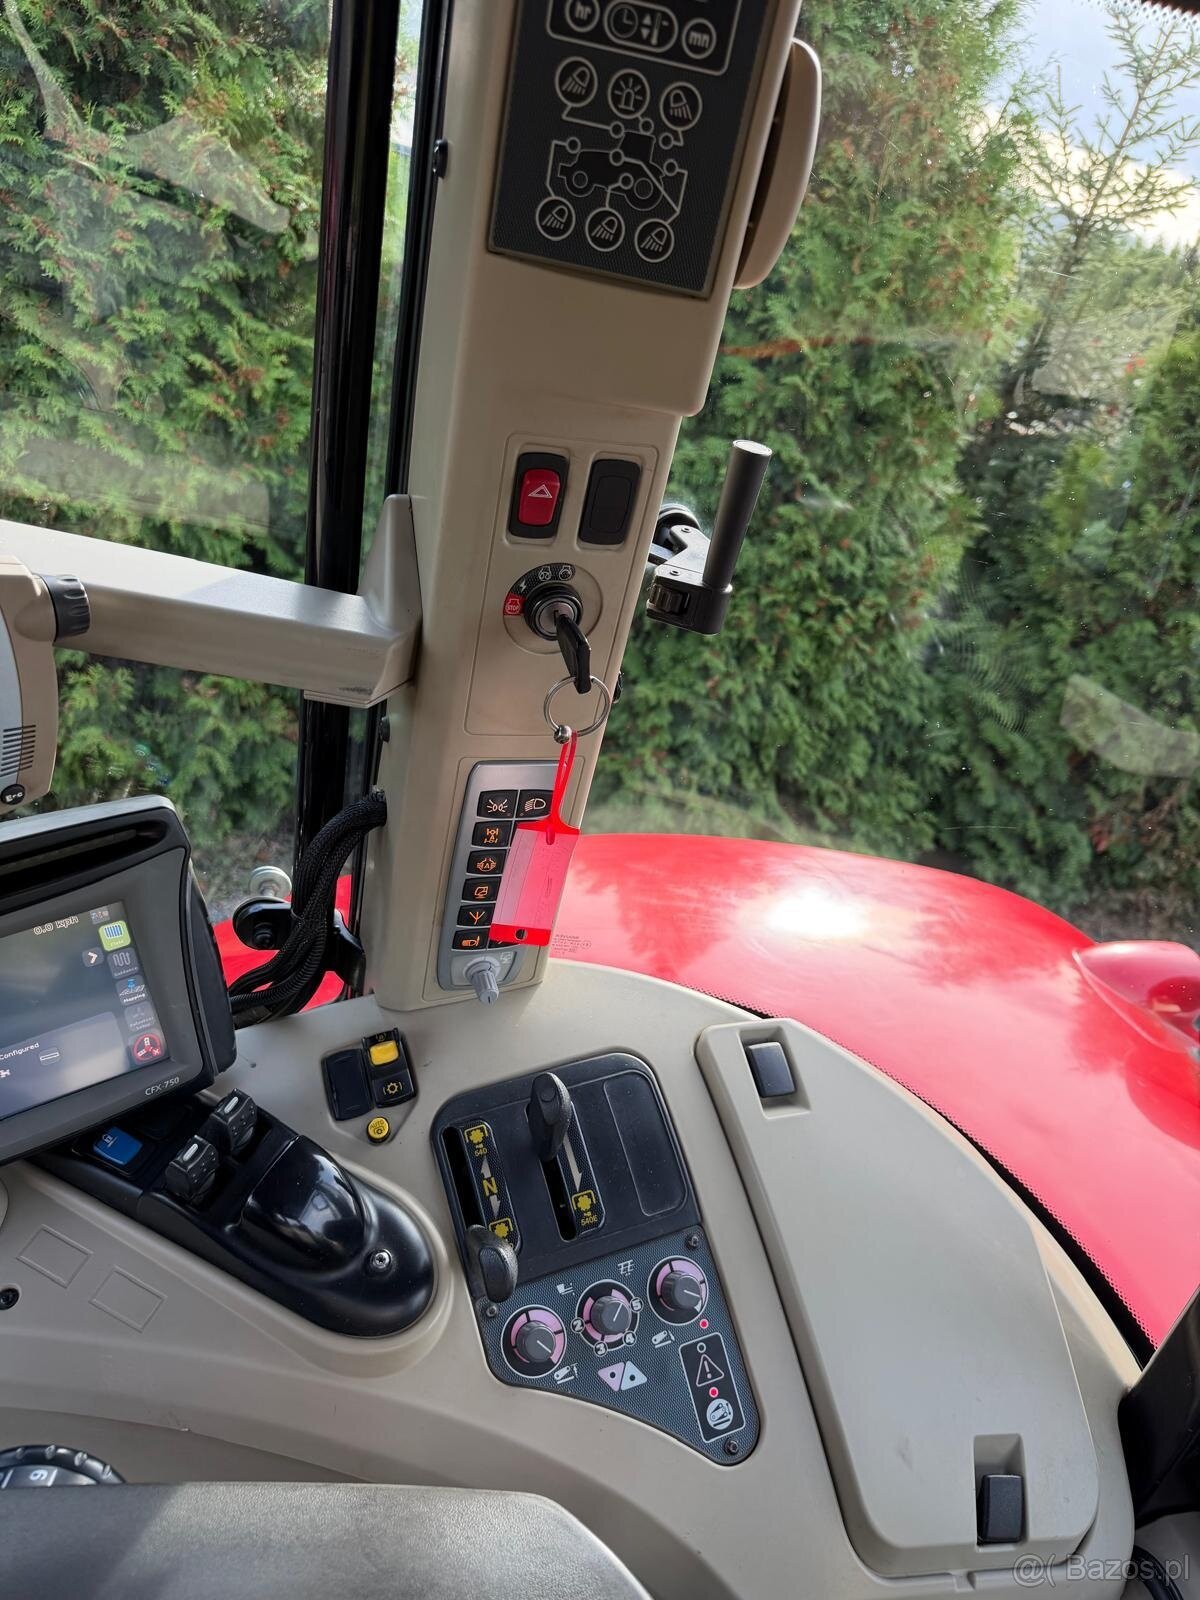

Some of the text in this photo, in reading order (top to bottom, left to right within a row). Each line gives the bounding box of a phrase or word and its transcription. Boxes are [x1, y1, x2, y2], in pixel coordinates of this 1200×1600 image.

[575, 2, 592, 21] hr
[688, 30, 711, 49] mn
[34, 916, 79, 935] 0.0 kph
[483, 1177, 498, 1197] N
[632, 1300, 641, 1309] 5
[573, 1320, 582, 1333] 2
[625, 1332, 634, 1344] 4
[595, 1342, 606, 1355] 3
